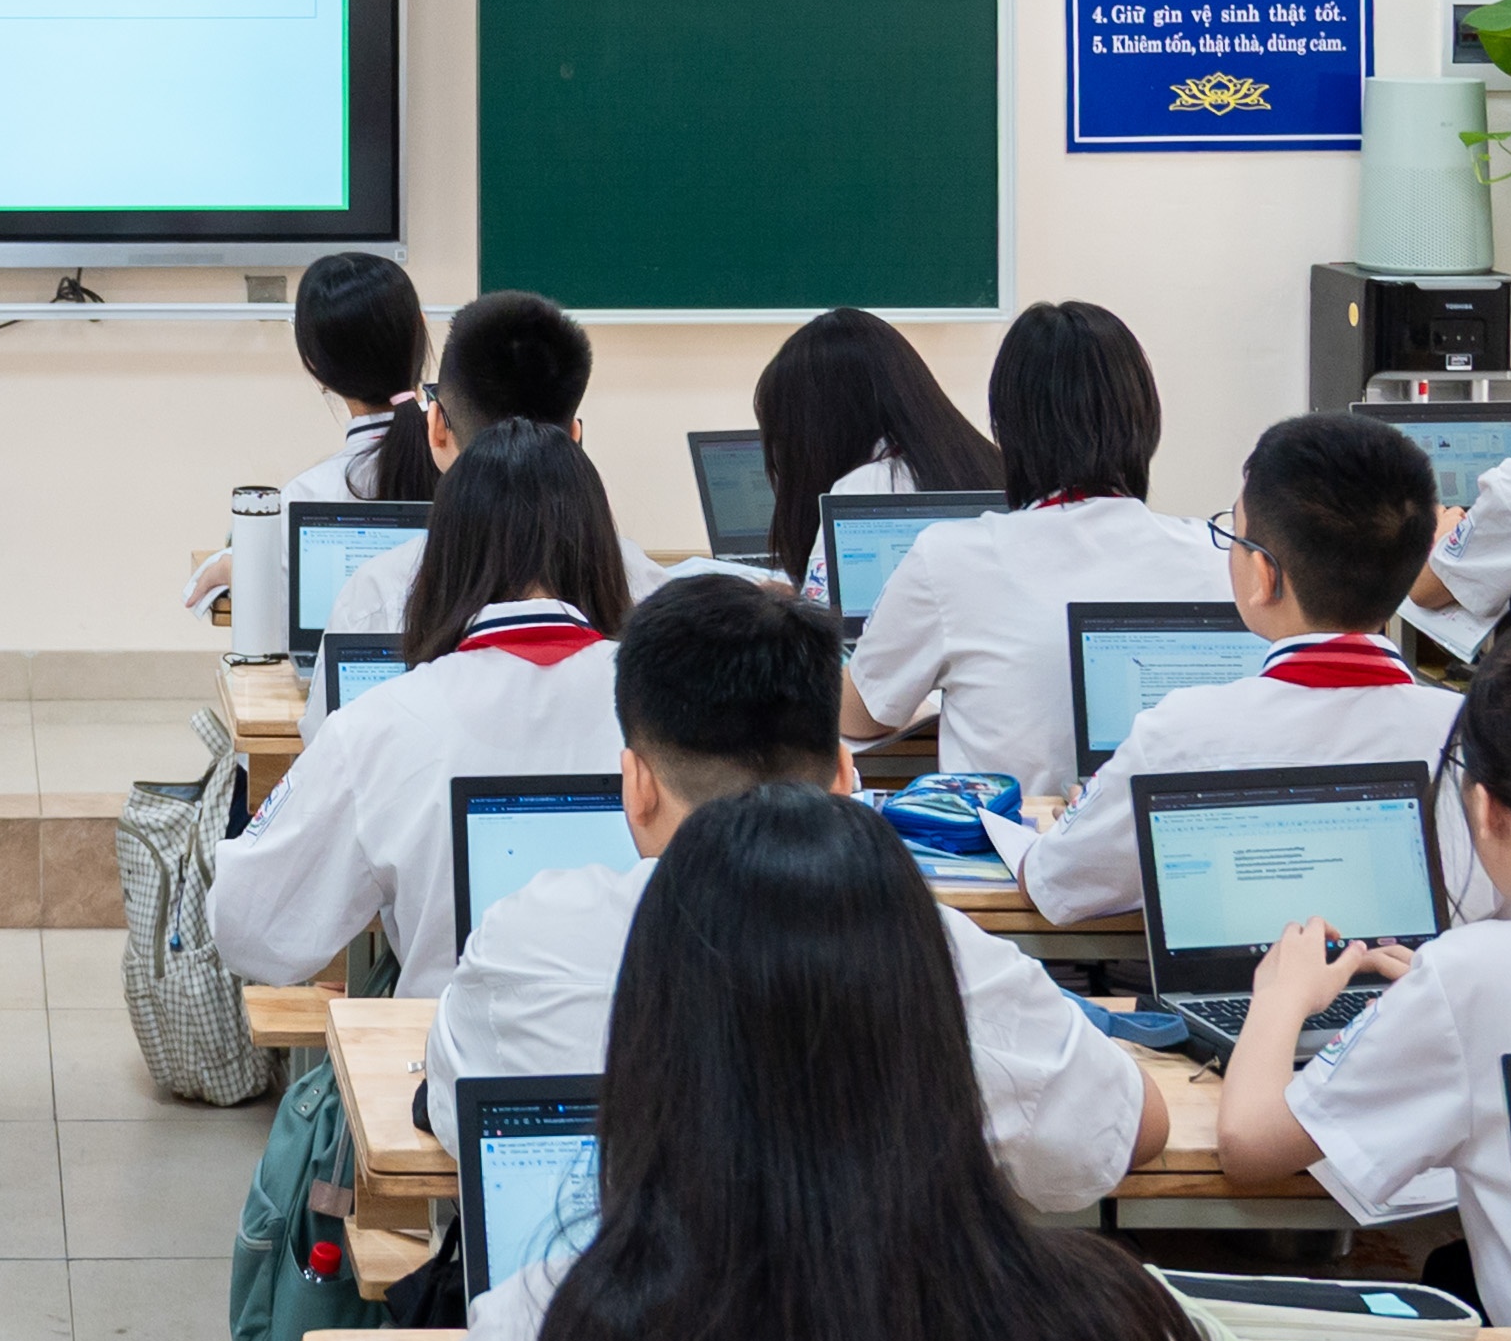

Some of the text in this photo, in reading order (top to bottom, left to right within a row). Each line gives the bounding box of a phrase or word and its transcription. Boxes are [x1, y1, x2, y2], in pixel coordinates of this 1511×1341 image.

[1092, 1, 1346, 27] 4. Giữ gìn vệ sinh thật tốt.
[1093, 32, 1346, 56] 5. Khiêm tốn, thật thà, dũng cảm.
